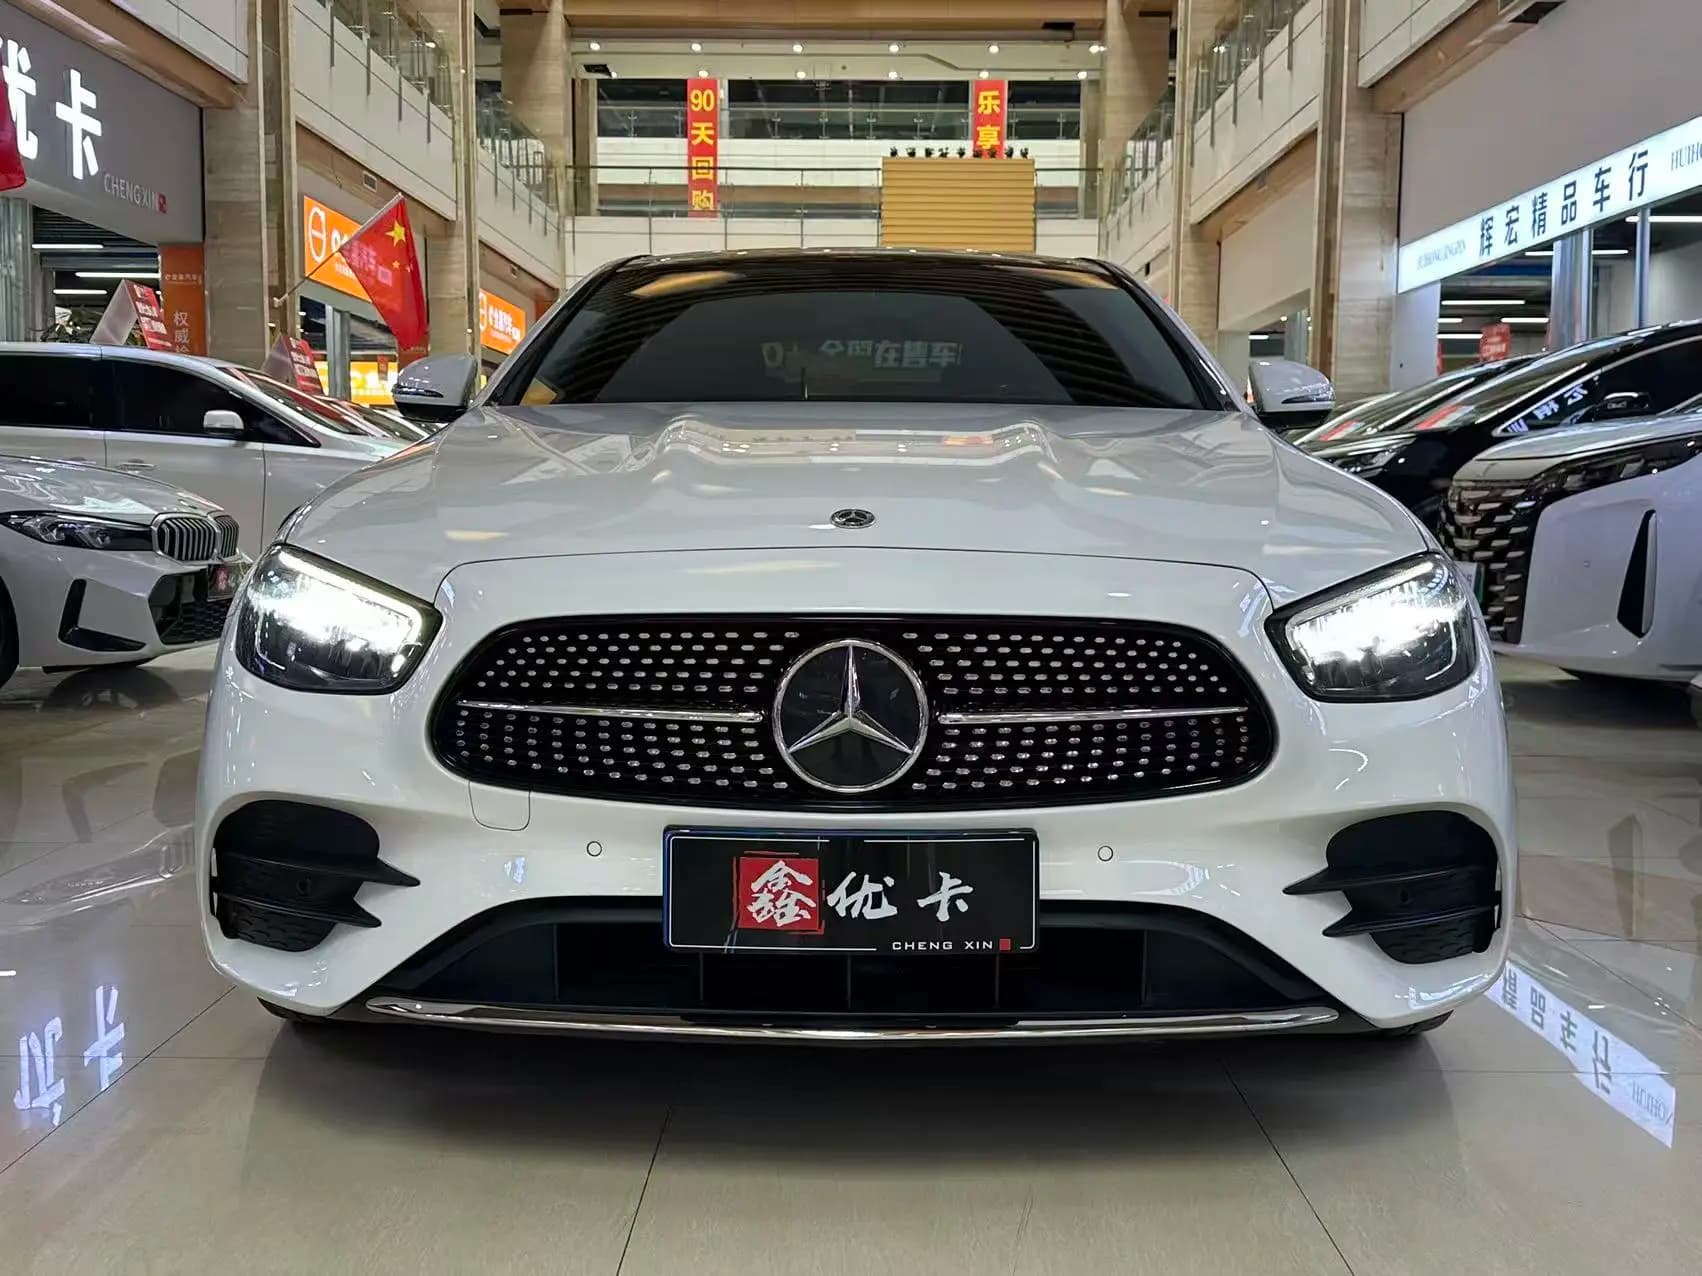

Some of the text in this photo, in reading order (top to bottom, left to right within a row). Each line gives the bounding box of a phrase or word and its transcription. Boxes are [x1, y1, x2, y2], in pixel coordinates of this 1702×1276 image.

[690, 88, 716, 211] 90天回购
[976, 90, 1001, 150] 乐享
[1478, 150, 1650, 258] 辉宏精品车行
[892, 940, 993, 951] CHENG XIN
